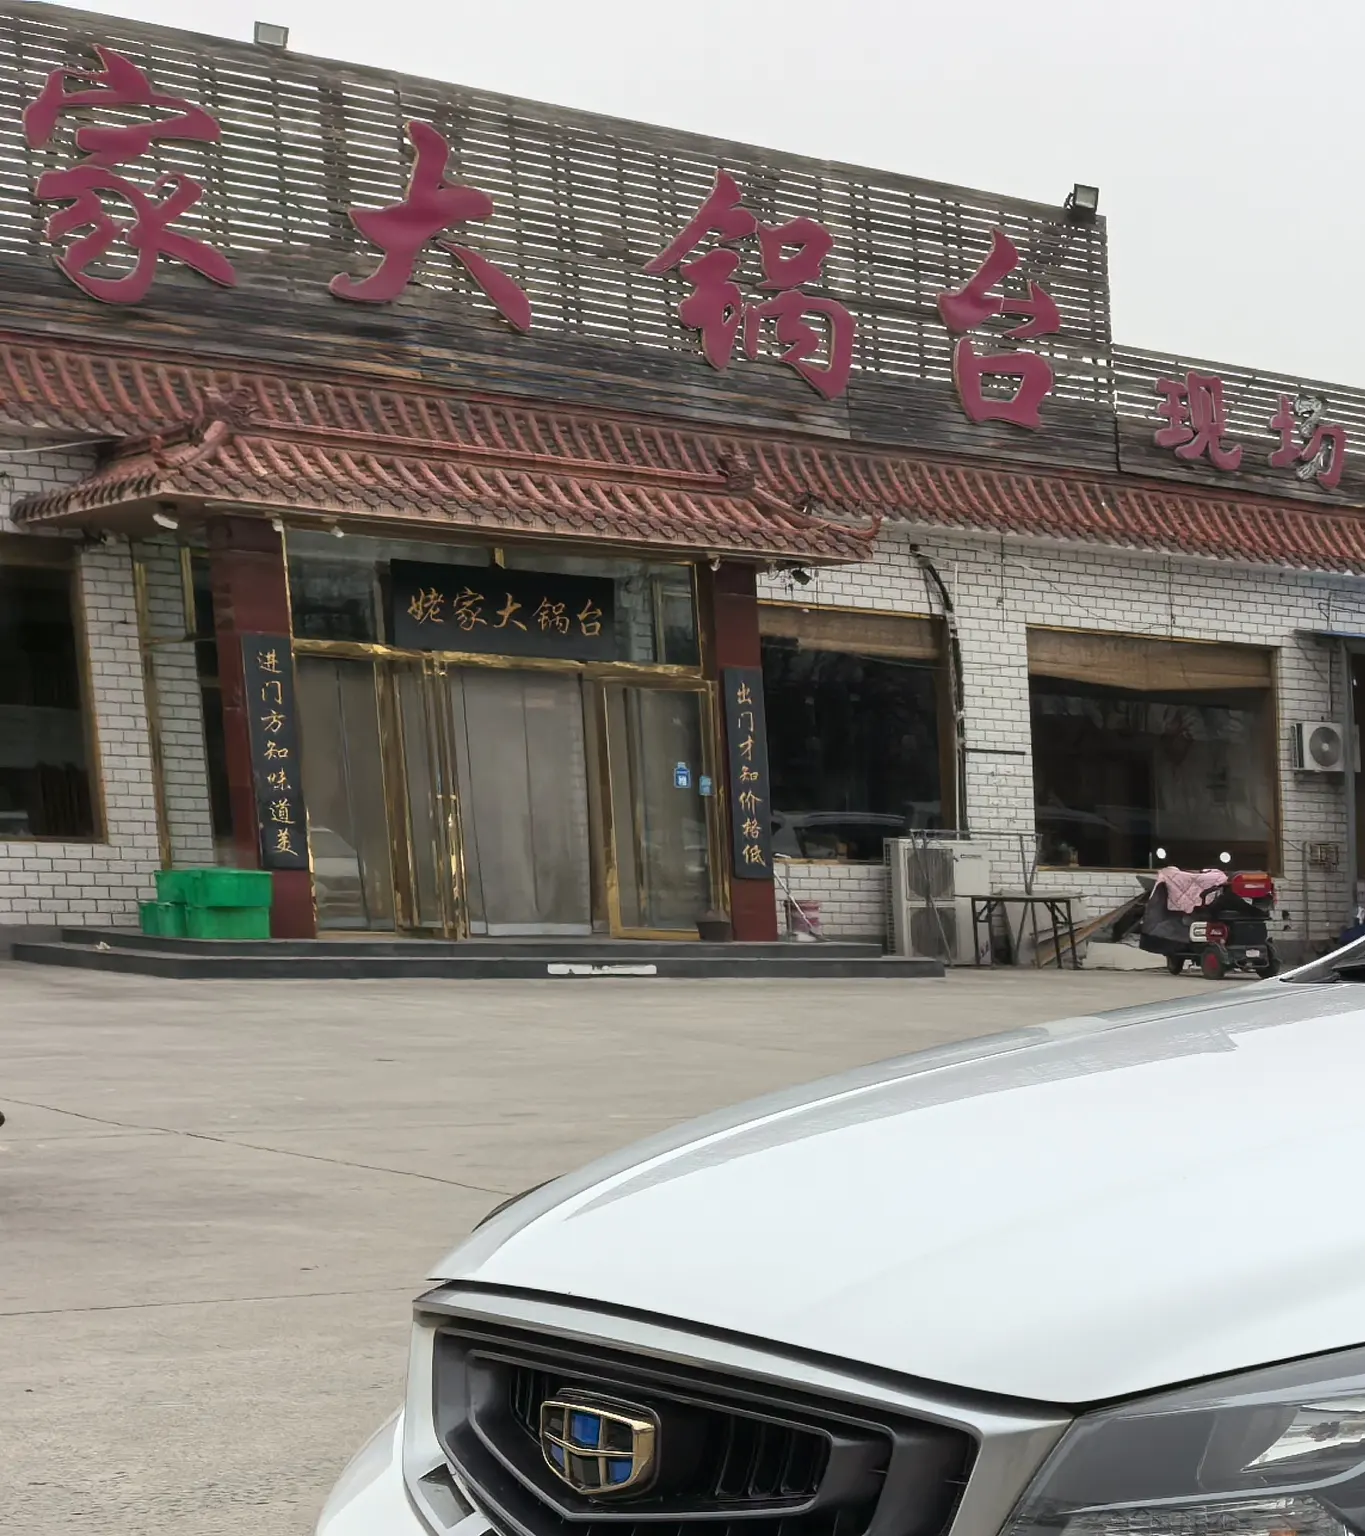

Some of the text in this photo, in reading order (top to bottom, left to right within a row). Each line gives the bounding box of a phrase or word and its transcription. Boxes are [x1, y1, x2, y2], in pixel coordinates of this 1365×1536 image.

[22, 44, 1062, 429] 家大锅台
[407, 586, 603, 637] 姥家大锅台
[257, 649, 299, 856] 进门方知味道美
[737, 682, 767, 867] 出门才知价格低
